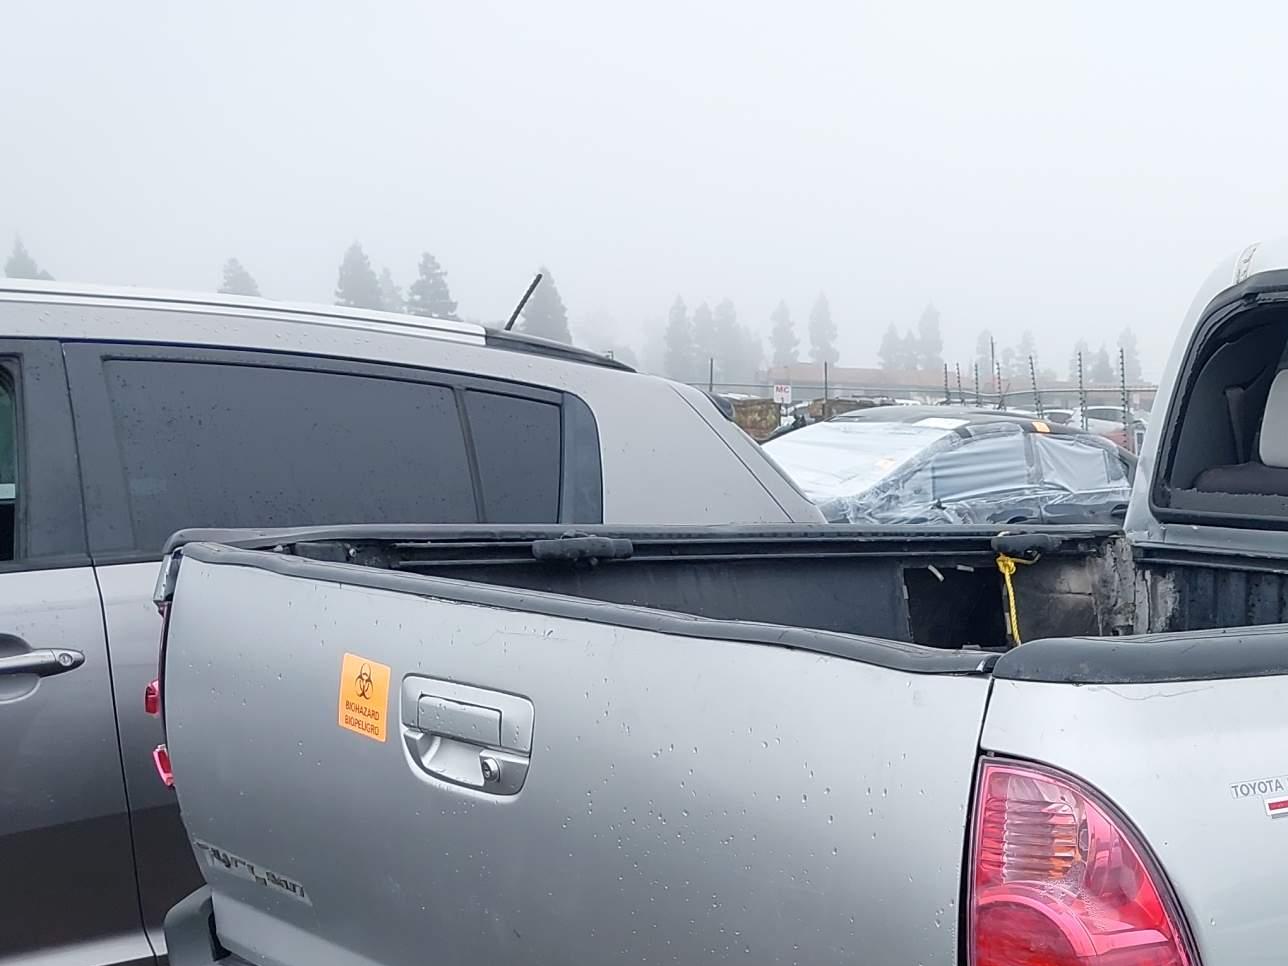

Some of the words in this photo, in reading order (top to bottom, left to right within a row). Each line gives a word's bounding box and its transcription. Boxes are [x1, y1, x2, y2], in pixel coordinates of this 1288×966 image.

[345, 700, 380, 721] BIOHAZARD
[344, 714, 380, 736] BIOPELIGRO
[1231, 779, 1285, 798] TOYOTA
